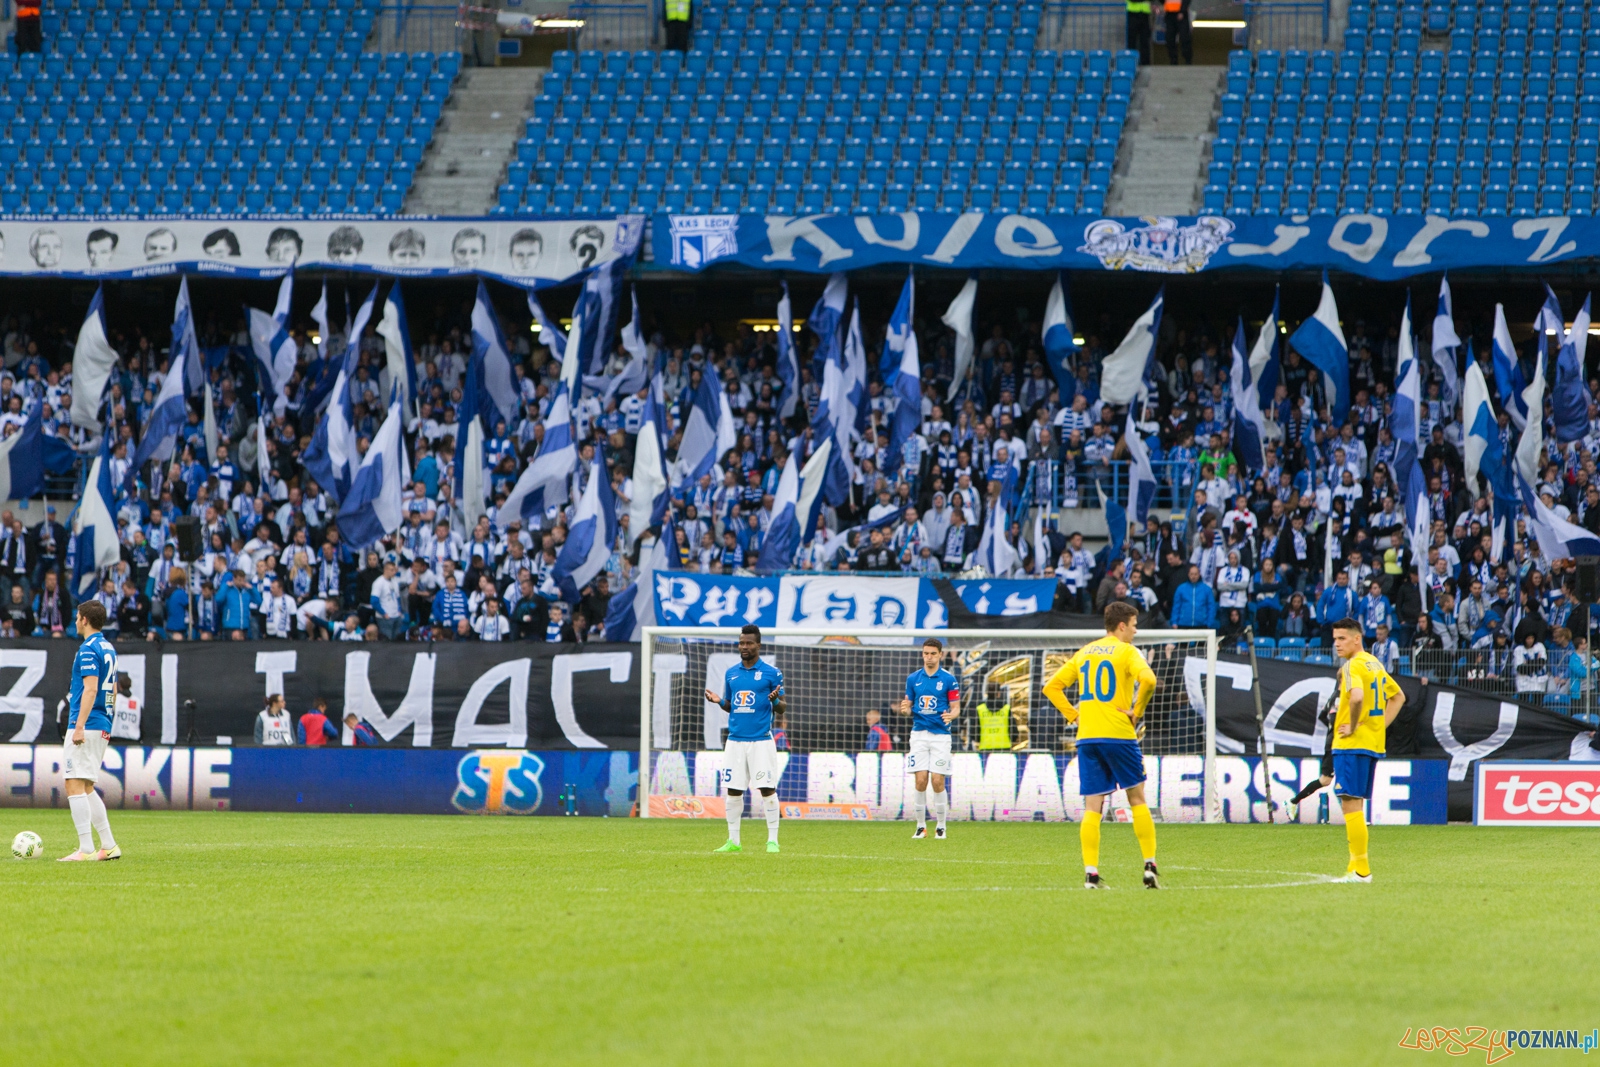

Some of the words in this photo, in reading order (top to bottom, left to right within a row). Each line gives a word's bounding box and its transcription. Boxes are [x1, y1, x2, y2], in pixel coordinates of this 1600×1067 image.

[679, 219, 699, 228] KKS
[704, 219, 730, 228] LECH
[1084, 645, 1116, 655] LIPSKI
[1080, 660, 1116, 702] 10
[734, 690, 756, 707] STS
[919, 695, 938, 710] STS
[452, 750, 545, 815] STS
[1494, 775, 1600, 815] tes
